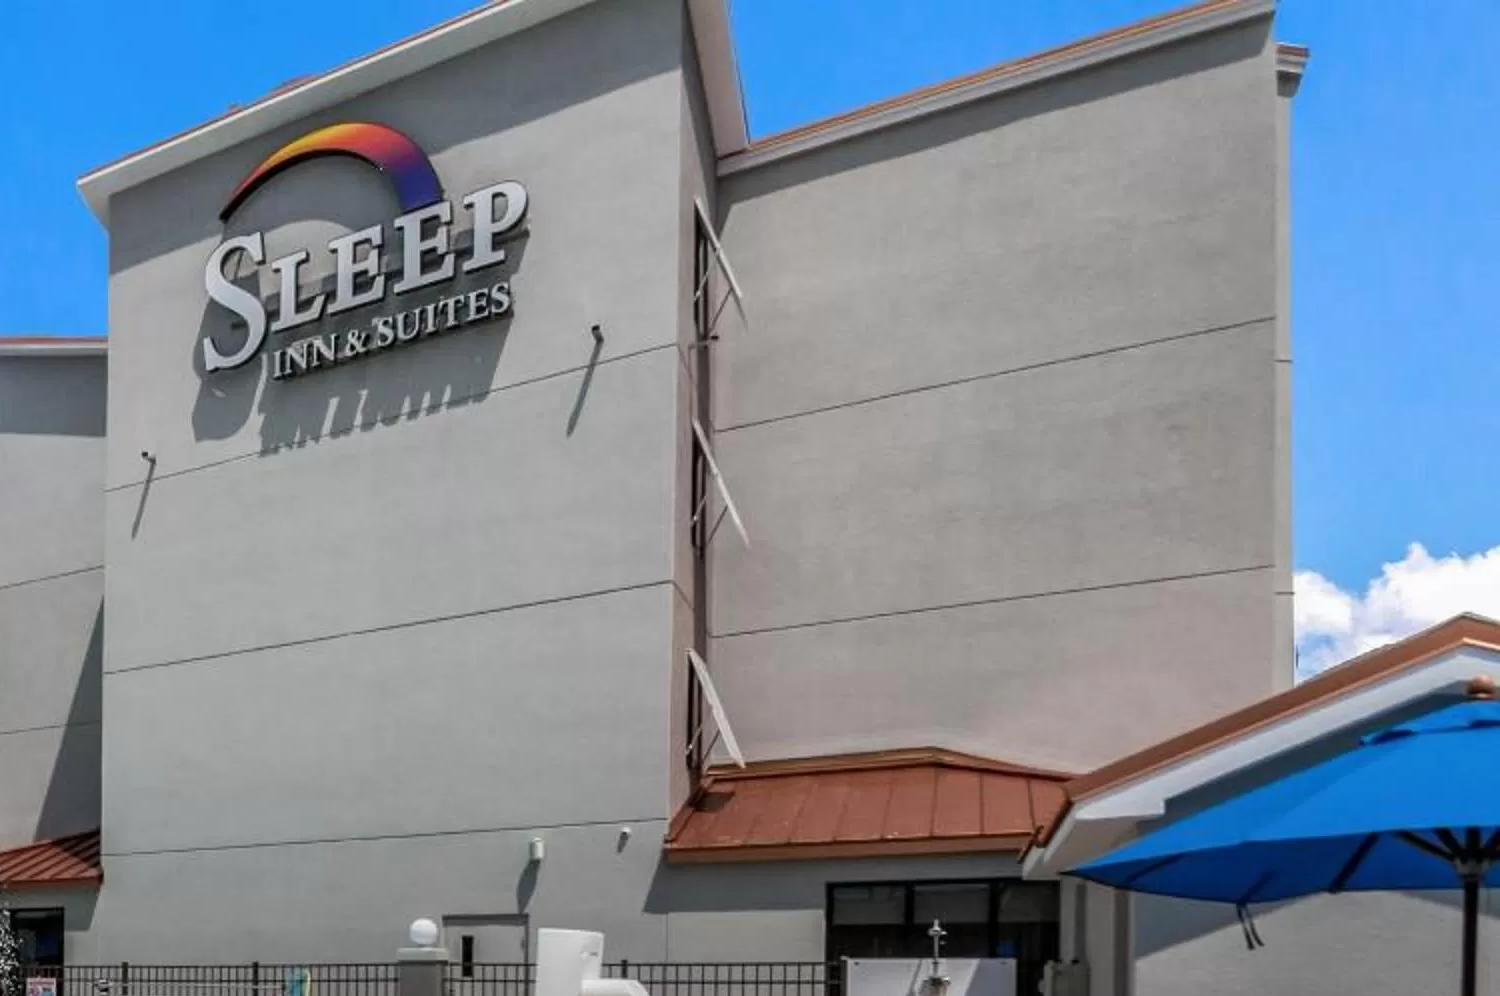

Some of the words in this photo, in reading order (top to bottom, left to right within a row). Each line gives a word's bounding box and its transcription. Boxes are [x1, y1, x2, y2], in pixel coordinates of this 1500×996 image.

[203, 179, 529, 372] SLEEP
[272, 334, 338, 379] INN
[344, 328, 372, 359] &
[374, 281, 513, 347] SUITES
